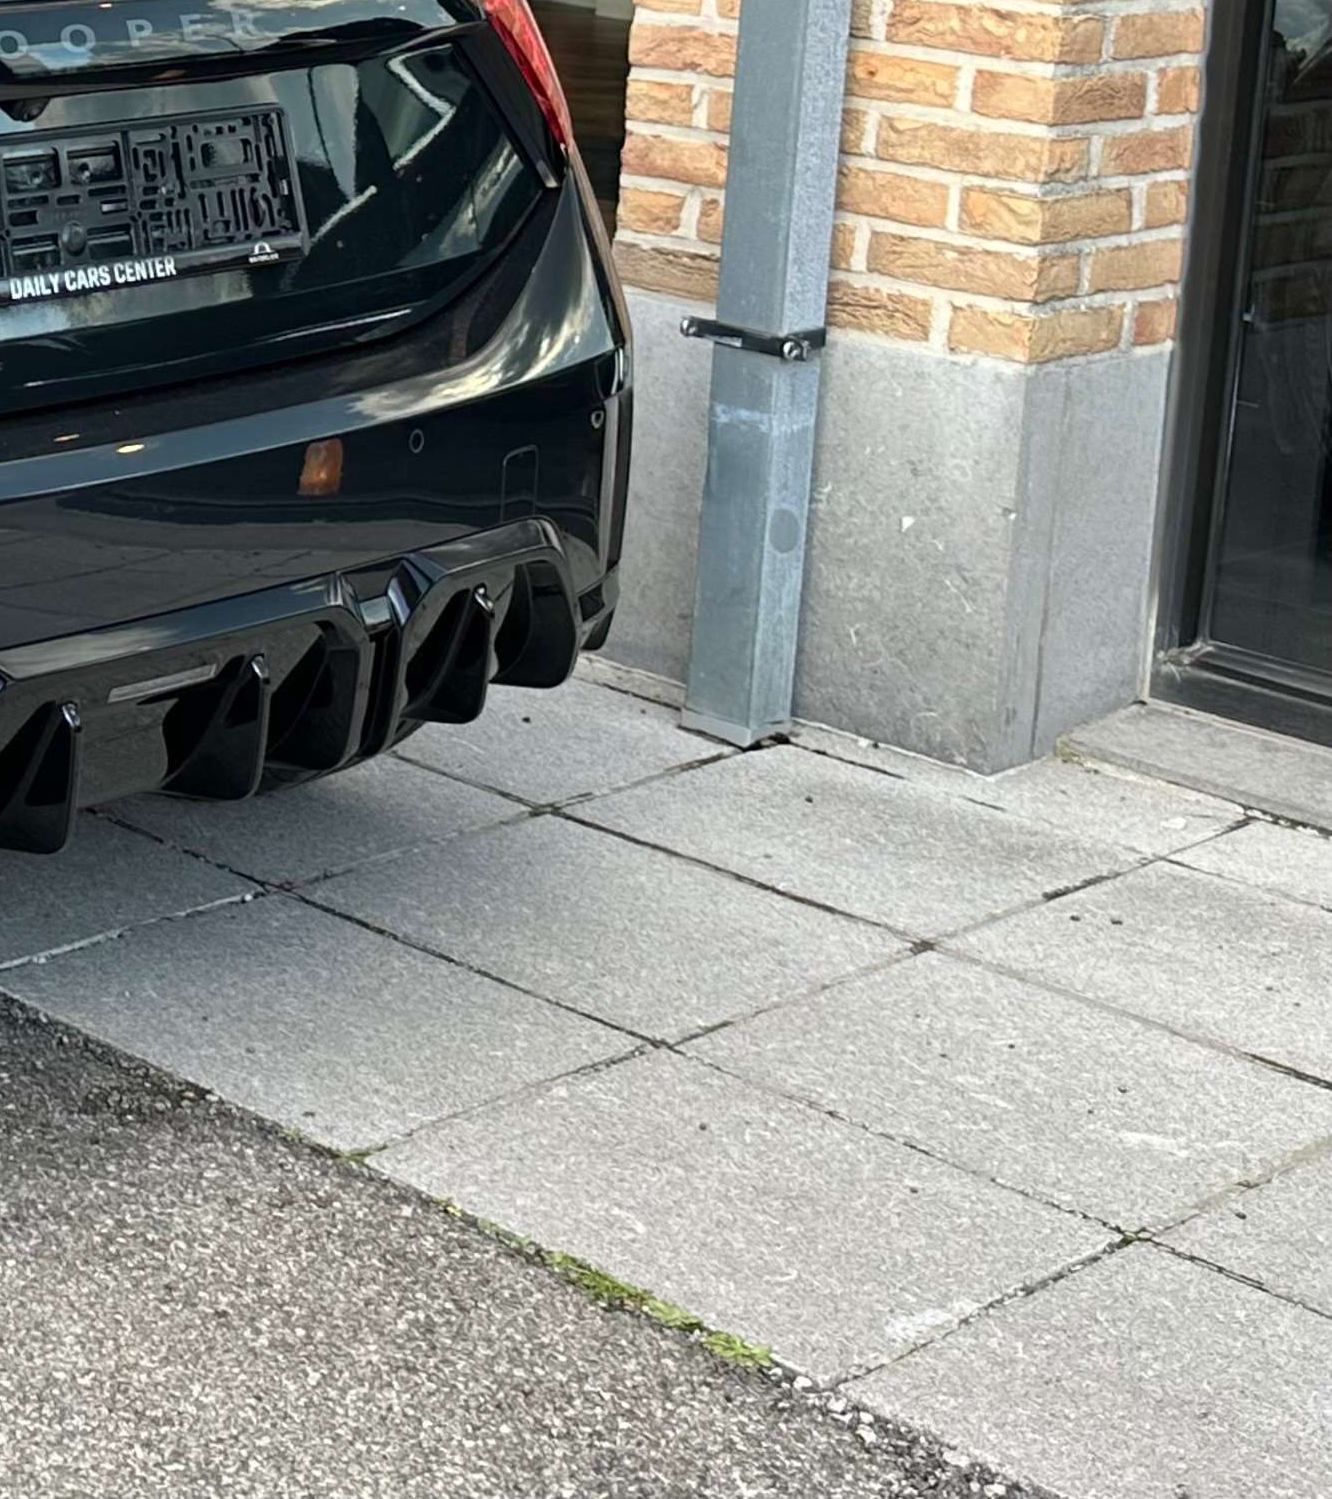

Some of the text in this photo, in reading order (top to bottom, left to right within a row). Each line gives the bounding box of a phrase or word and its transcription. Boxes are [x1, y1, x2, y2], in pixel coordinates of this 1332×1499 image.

[9, 255, 177, 300] DAILY CARS CENTER
